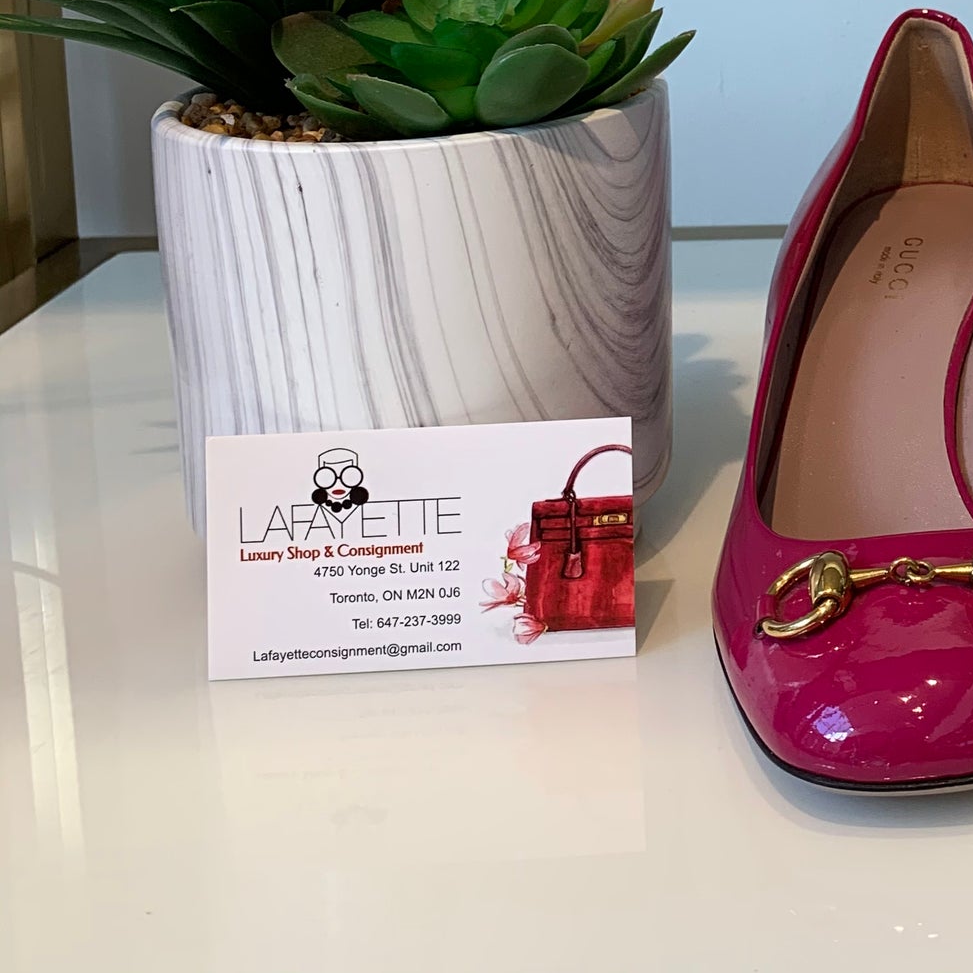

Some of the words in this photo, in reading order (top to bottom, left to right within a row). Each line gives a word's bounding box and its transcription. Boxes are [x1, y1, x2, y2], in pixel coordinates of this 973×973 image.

[884, 237, 924, 299] GUCCI
[240, 497, 462, 544] LAFAYETTE
[240, 548, 284, 563] Luxury
[287, 546, 321, 561] Shop
[324, 545, 335, 558] &
[337, 542, 424, 559] Consignment
[313, 565, 345, 578] 4750
[347, 564, 386, 578] Yonge
[389, 563, 406, 574] St.
[409, 561, 434, 574] Unit
[438, 560, 460, 572] 122
[329, 592, 379, 605] Toronto,
[382, 589, 403, 602] ON
[406, 588, 435, 600] M2N
[438, 586, 461, 599] 0J6
[351, 618, 373, 630] Tel:
[376, 613, 462, 629] 647-237-3999
[253, 642, 462, 663] Lafayetteconsignment@gmail.com
